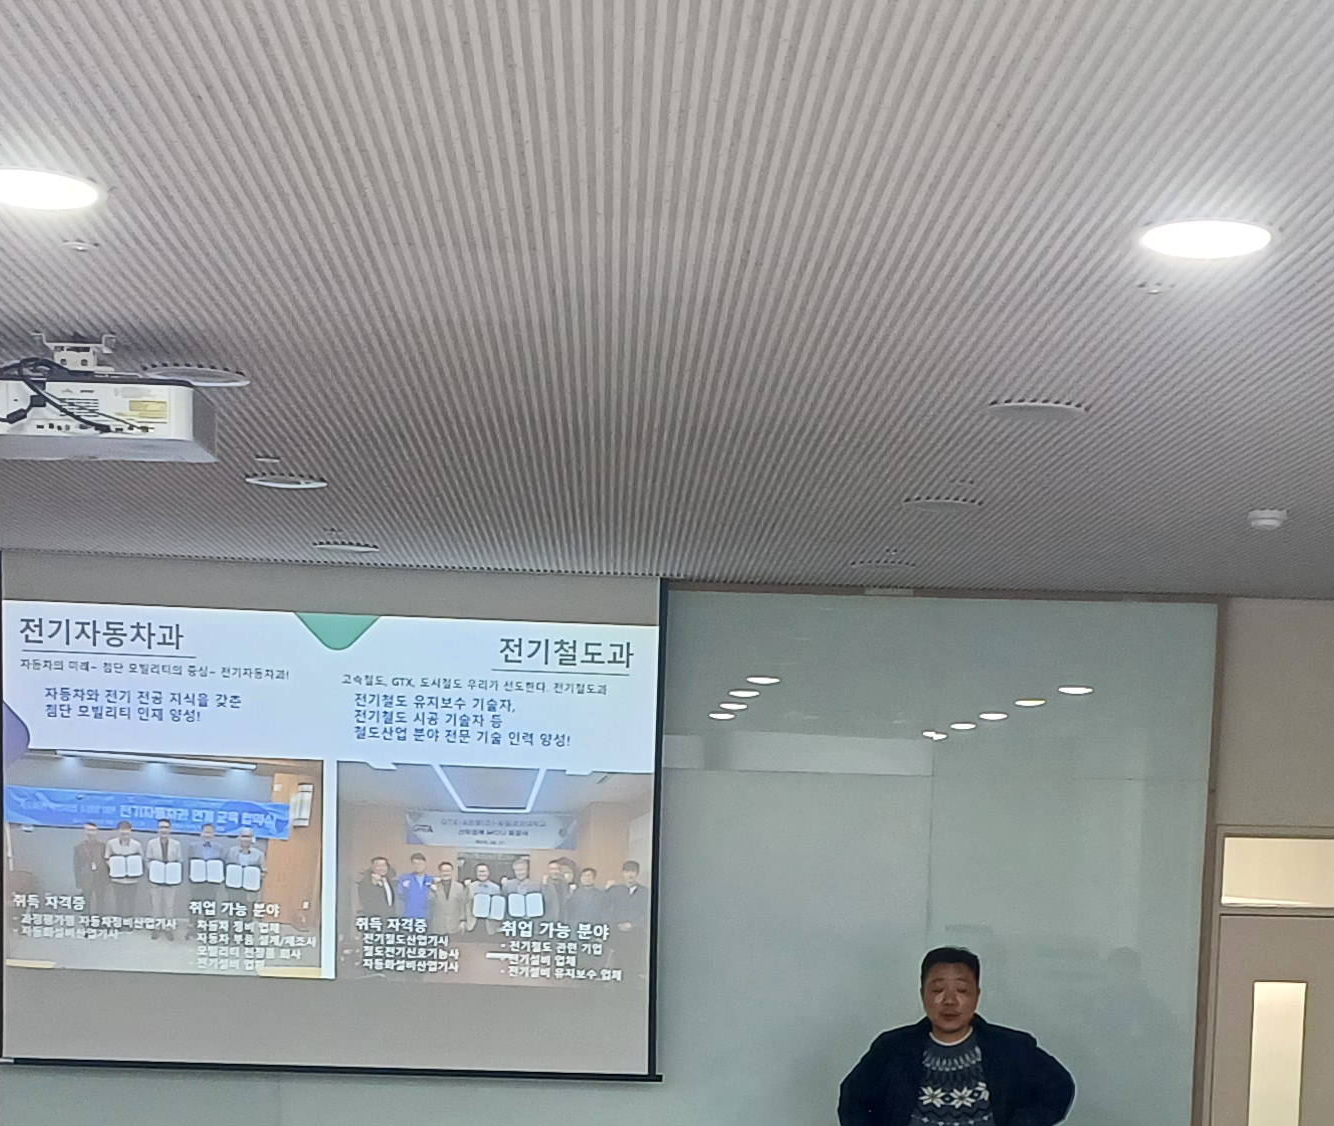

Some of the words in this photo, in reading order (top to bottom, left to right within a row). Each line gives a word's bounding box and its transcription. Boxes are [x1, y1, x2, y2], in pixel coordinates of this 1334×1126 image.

[19, 617, 184, 650] 전기자동차과
[499, 637, 634, 668] 전기철도과
[20, 658, 64, 672] 자동차의
[103, 662, 123, 674] 첨단
[128, 663, 183, 676] 모빌리티의
[220, 667, 290, 680] 전기자동차과!
[420, 677, 463, 690] 도시철도
[467, 678, 499, 692] 우리가
[553, 682, 607, 696] 전기철도과
[44, 686, 100, 703] 자동차와
[105, 688, 131, 704] 전기
[137, 690, 163, 706] 전공
[169, 692, 209, 708] 지식을
[215, 693, 242, 709] 갖춘
[354, 693, 407, 708] 전기철도
[413, 694, 467, 710] 유지보수
[472, 696, 516, 713] 기술자,
[45, 703, 72, 718] 첨단
[77, 704, 131, 720] 모빌리티
[137, 706, 163, 721] 인재
[169, 707, 201, 723] 양성!
[354, 709, 407, 725] 전기철도
[413, 710, 439, 726] 시공
[445, 712, 485, 728] 기술자
[489, 714, 503, 729] 등
[354, 725, 407, 741] 철도산업
[413, 727, 439, 743] 분야
[444, 728, 471, 744] 전문
[476, 730, 502, 746] 기술
[508, 731, 534, 747] 인력
[540, 732, 571, 748] 양성!
[13, 894, 40, 910] 취득
[45, 895, 86, 911] 자격증
[189, 900, 217, 916] 취업
[221, 902, 248, 918] 가능
[252, 902, 280, 919] 분야
[78, 915, 177, 932] 자동차정비산업기사
[197, 919, 229, 932] 자동차
[233, 920, 255, 933] 정비
[258, 922, 280, 934] 업체
[356, 917, 383, 932] 취득
[387, 917, 428, 934] 자격증
[501, 920, 533, 938] 취업
[539, 921, 571, 940] 가능
[576, 922, 610, 941] 분야
[196, 932, 229, 945] 자동차
[233, 934, 255, 946] 부품
[362, 933, 449, 948] 전기철도산업기사
[197, 945, 240, 958] 모빌리티
[362, 946, 460, 961] 철도전기신호기능사
[509, 940, 552, 953] 전기철도
[556, 941, 578, 955] 관련
[581, 942, 603, 956] 기업
[197, 957, 240, 970] 전기설비
[362, 959, 459, 974] 자동화설비산업기사
[508, 953, 551, 967] 전기설비
[554, 954, 577, 968] 업체
[508, 966, 551, 979] 전기설비
[554, 968, 598, 981] 유지보수
[601, 968, 622, 982] 업체
